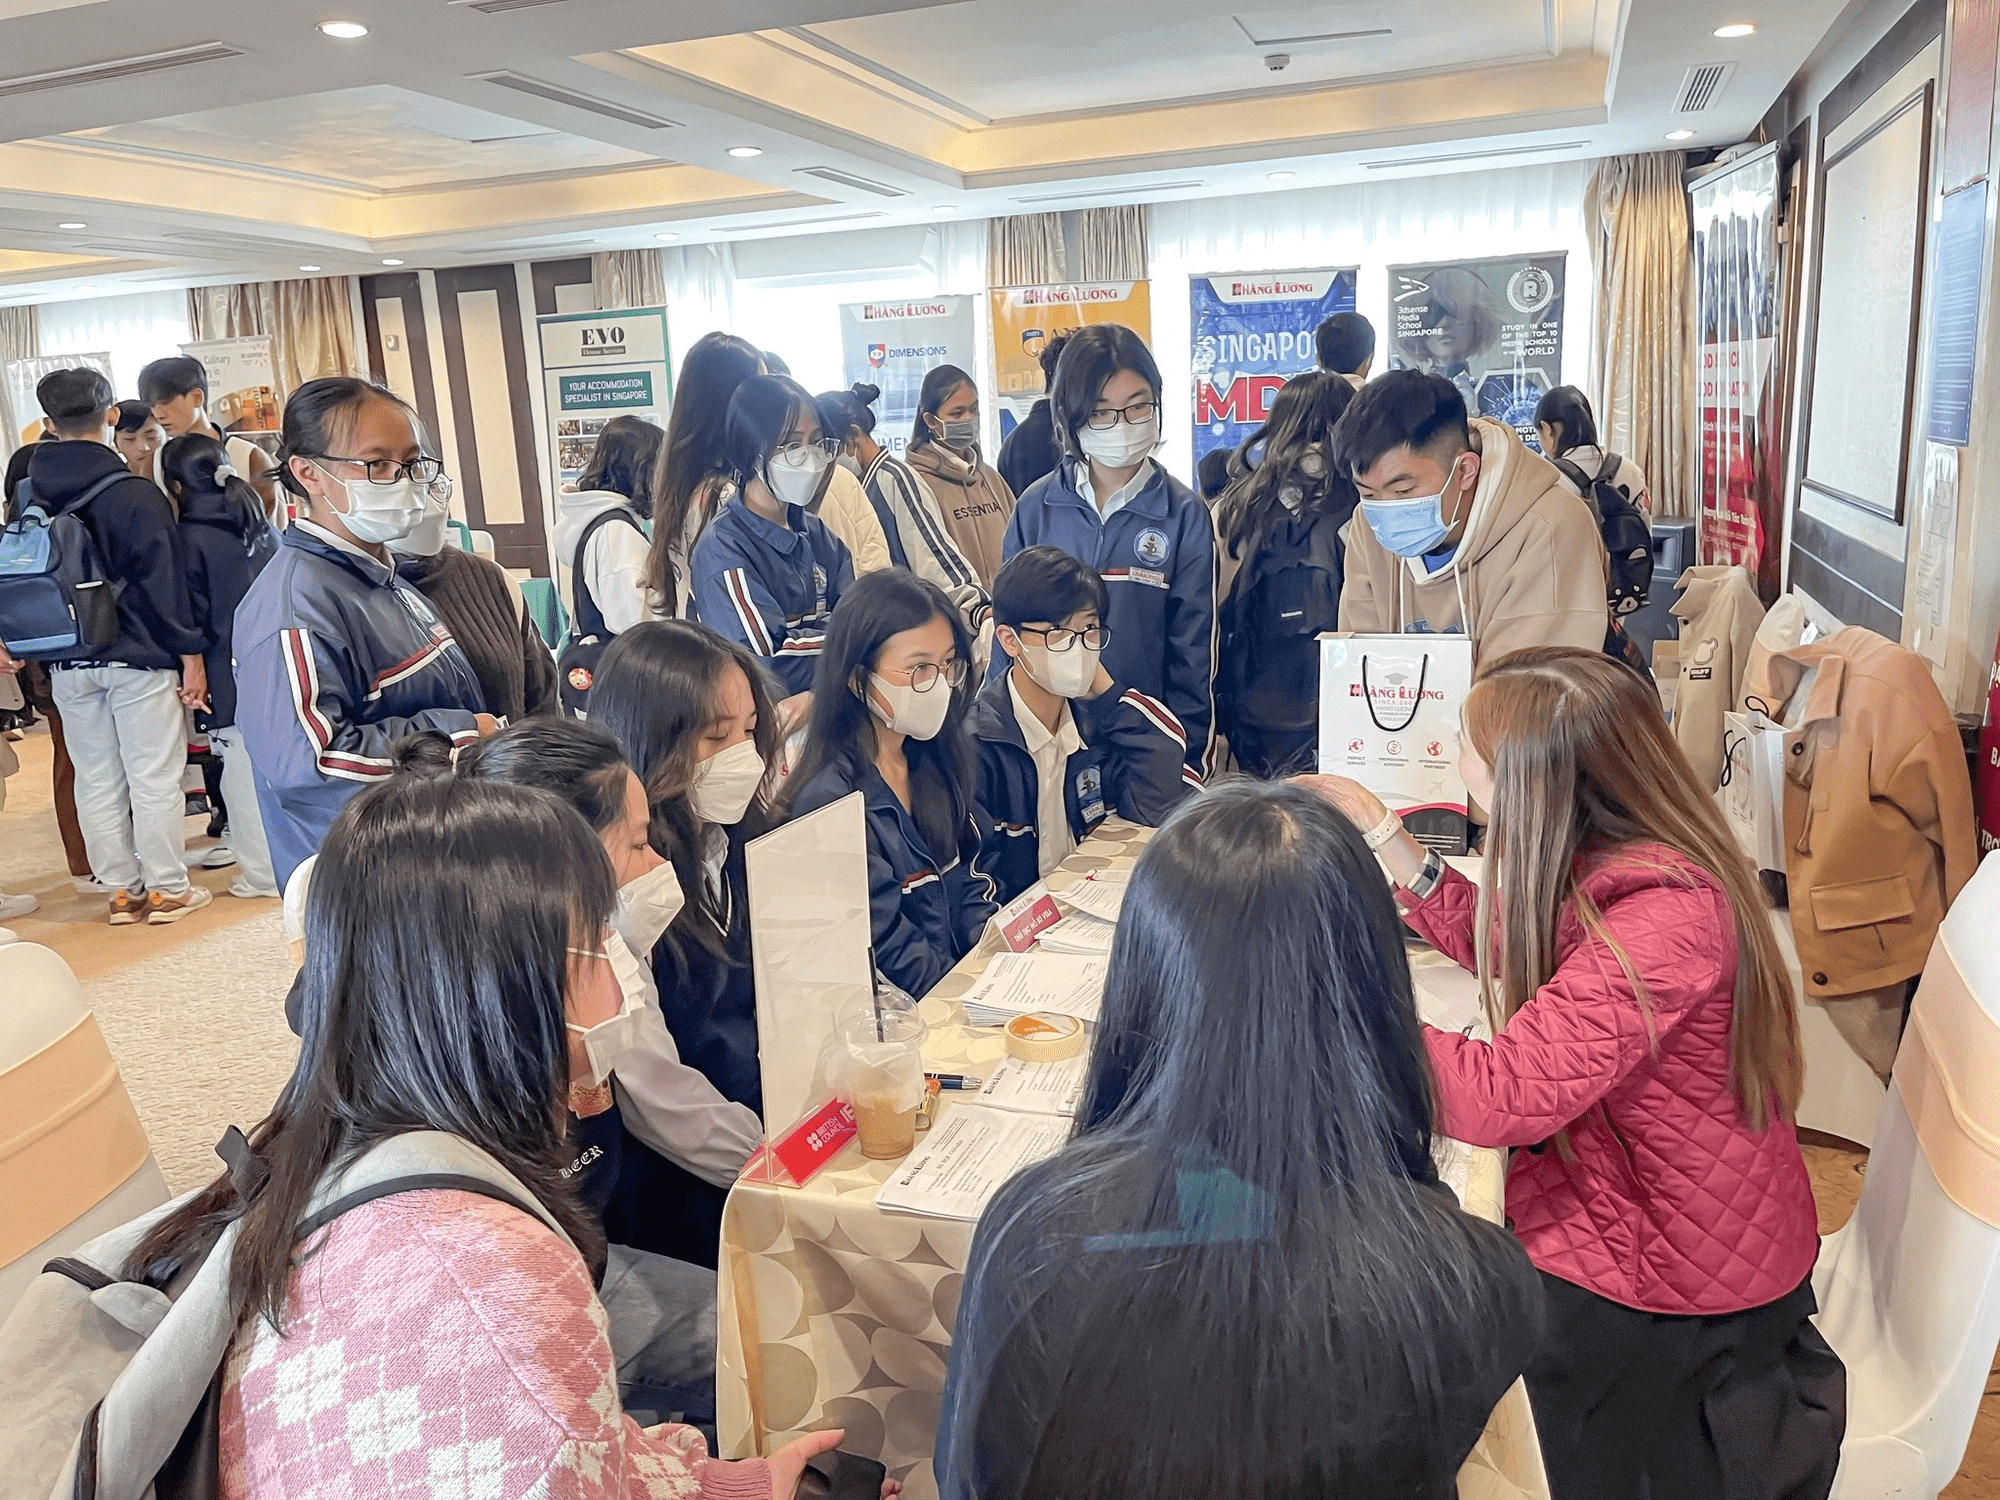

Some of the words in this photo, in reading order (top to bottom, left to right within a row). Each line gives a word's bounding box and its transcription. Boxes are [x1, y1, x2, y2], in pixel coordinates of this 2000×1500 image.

[1397, 321, 1422, 330] School
[1501, 324, 1525, 332] STUDY
[1541, 321, 1558, 329] ONE
[581, 326, 625, 346] EVO
[1397, 327, 1443, 338] SINGAPORE
[1501, 332, 1512, 340] OF
[1549, 329, 1558, 337] 10
[1200, 330, 1316, 364] SINGAPO
[1524, 338, 1558, 347] SCHOOLS
[888, 345, 948, 358] DIMENSIONS
[1518, 346, 1556, 357] WORLD
[568, 382, 587, 391] YOUR
[587, 378, 643, 390] ACCOMMODATION
[564, 392, 602, 404] SPECIALIST
[602, 392, 611, 401] IN
[611, 390, 648, 401] SINGAPORE
[815, 1115, 839, 1137] BRITISH
